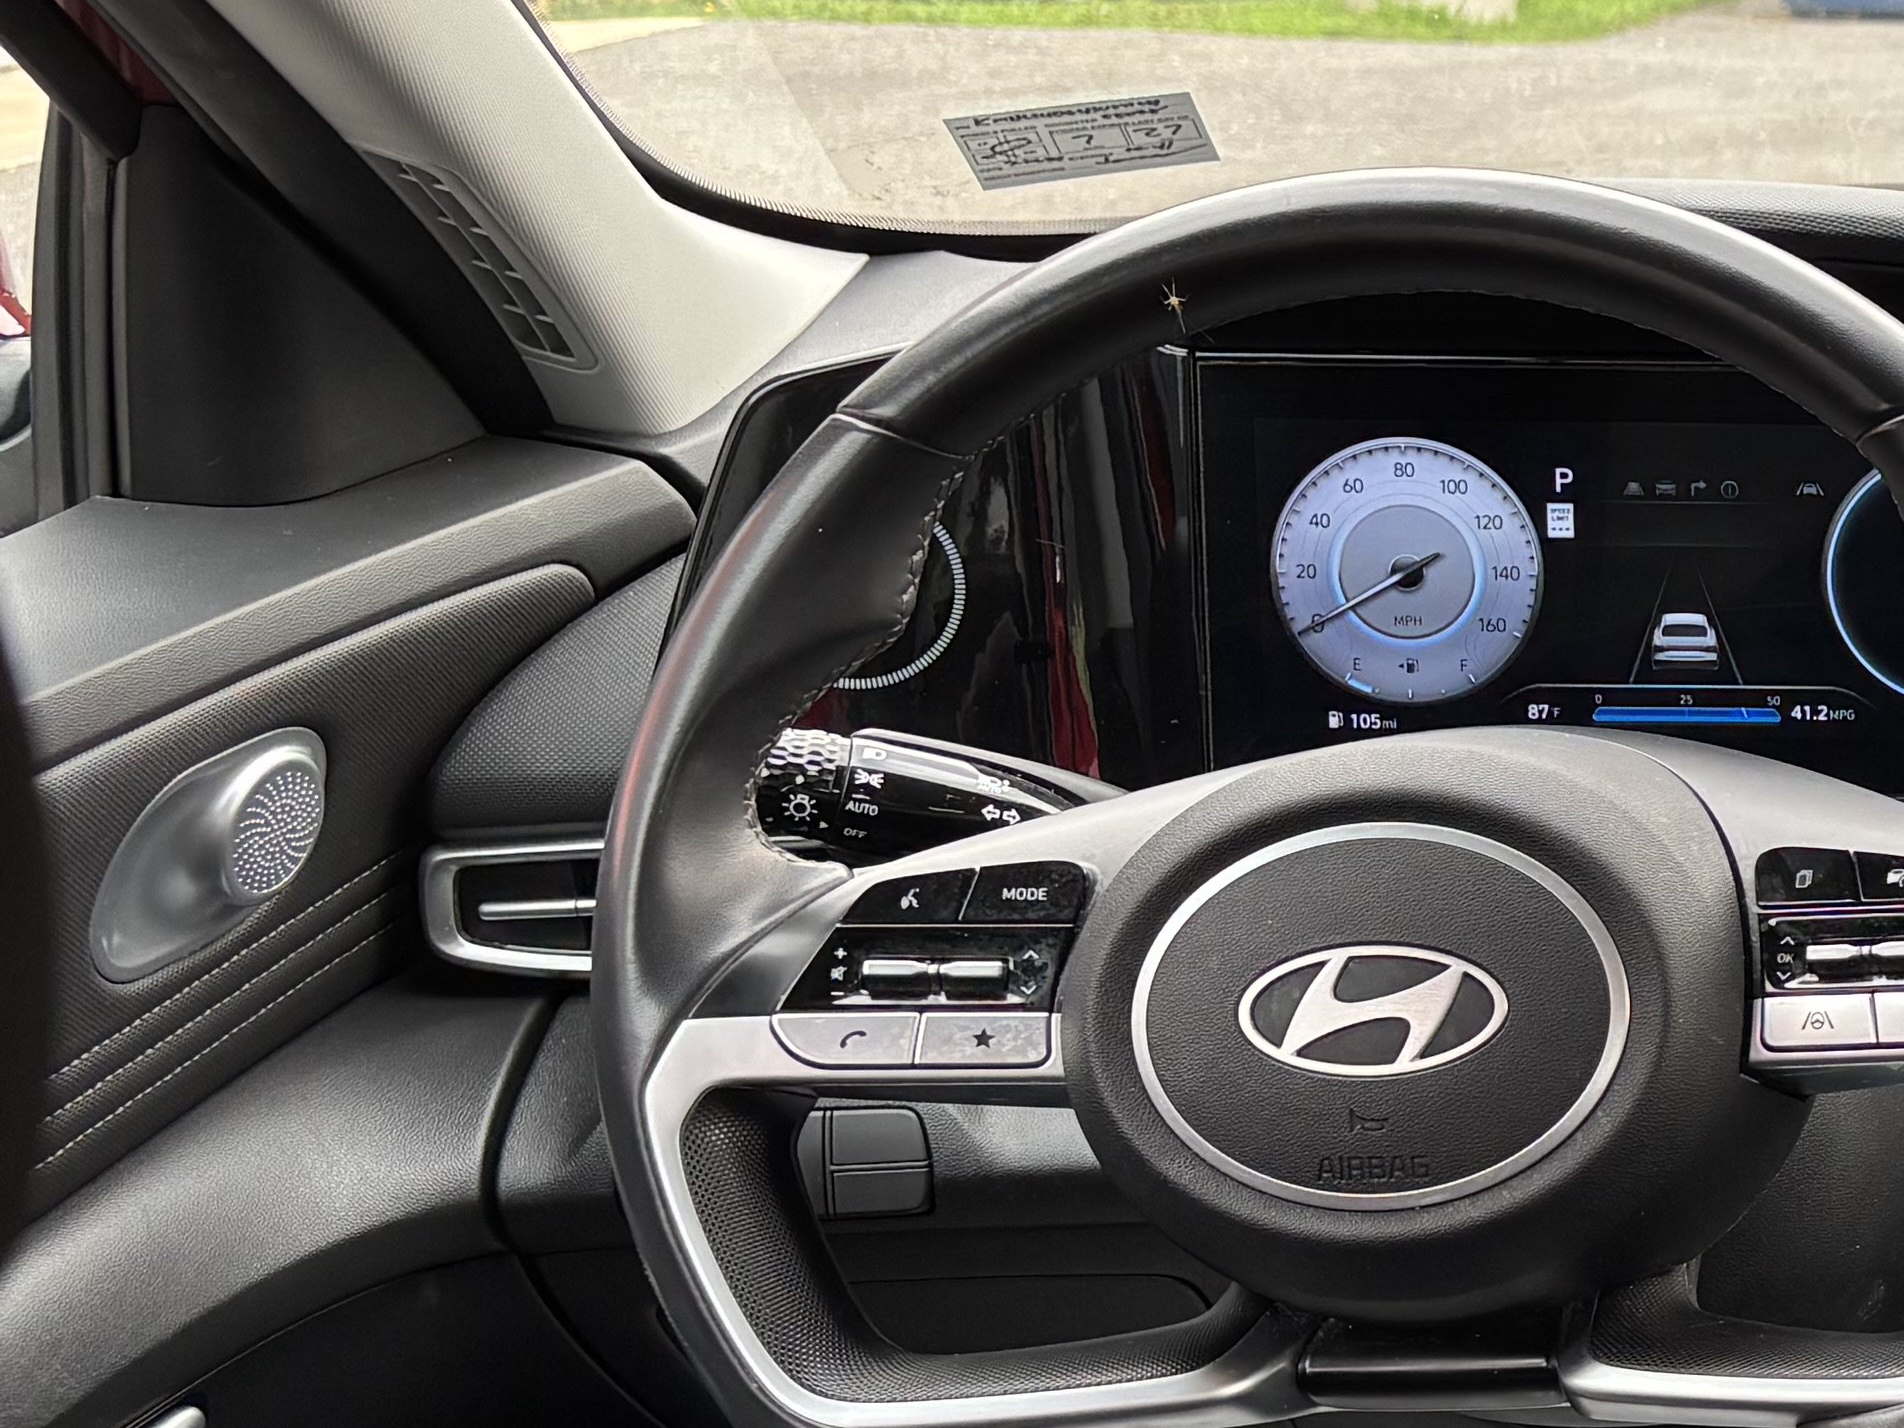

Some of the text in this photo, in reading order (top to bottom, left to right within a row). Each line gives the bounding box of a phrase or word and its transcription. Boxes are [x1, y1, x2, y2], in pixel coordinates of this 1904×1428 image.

[1393, 462, 1415, 477] 80
[1342, 478, 1364, 494] 60
[1439, 479, 1468, 495] 100
[1554, 467, 1574, 493] P
[1309, 513, 1331, 529] 40
[1474, 514, 1504, 530] 120
[1295, 563, 1317, 579] 20
[1491, 565, 1521, 581] 140
[1310, 613, 1325, 633] 0
[1394, 616, 1423, 627] MPH
[1478, 618, 1507, 633] 160
[1353, 658, 1362, 671] E
[1460, 659, 1468, 671] F
[1594, 694, 1602, 703] 0
[1679, 696, 1693, 705] 25
[1766, 696, 1781, 706] 50
[845, 800, 879, 817] AUTO
[843, 827, 867, 839] OFF
[1002, 887, 1048, 901] MODE
[1776, 952, 1794, 964] OK
[1317, 1155, 1430, 1182] AIRBAG
